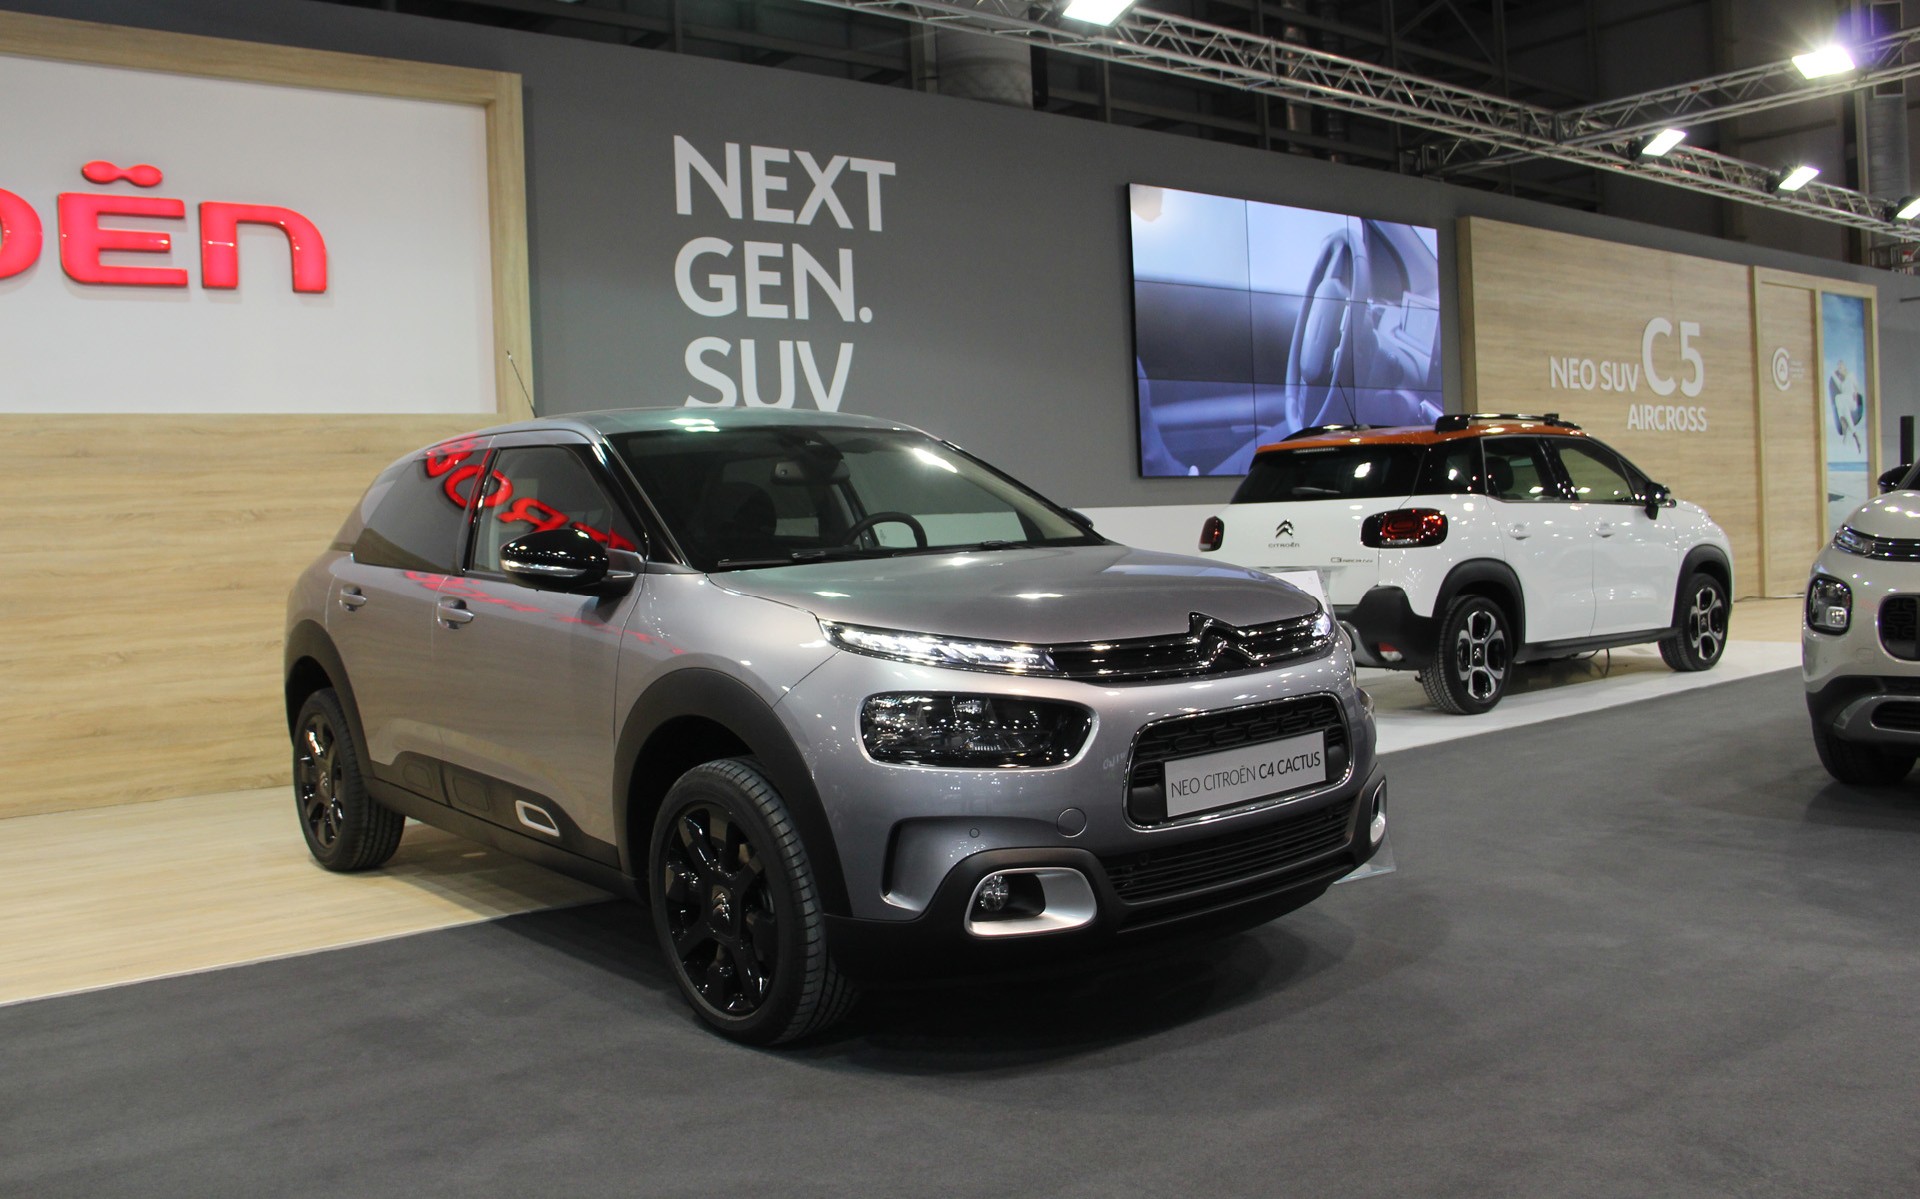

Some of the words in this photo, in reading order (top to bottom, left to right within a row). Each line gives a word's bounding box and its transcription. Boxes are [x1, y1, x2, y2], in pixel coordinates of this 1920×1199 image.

[674, 135, 895, 231] NEXT
[675, 236, 873, 323] GEN.
[684, 336, 854, 412] SUV
[1550, 356, 1597, 391] NEO
[1600, 361, 1639, 392] SUV
[1642, 317, 1704, 397] C5
[1627, 404, 1708, 432] AIRCROSS
[1171, 777, 1200, 798] NEO
[1203, 765, 1256, 791] CITROËN
[1259, 764, 1275, 779] C4
[1277, 751, 1321, 773] CACTUS
